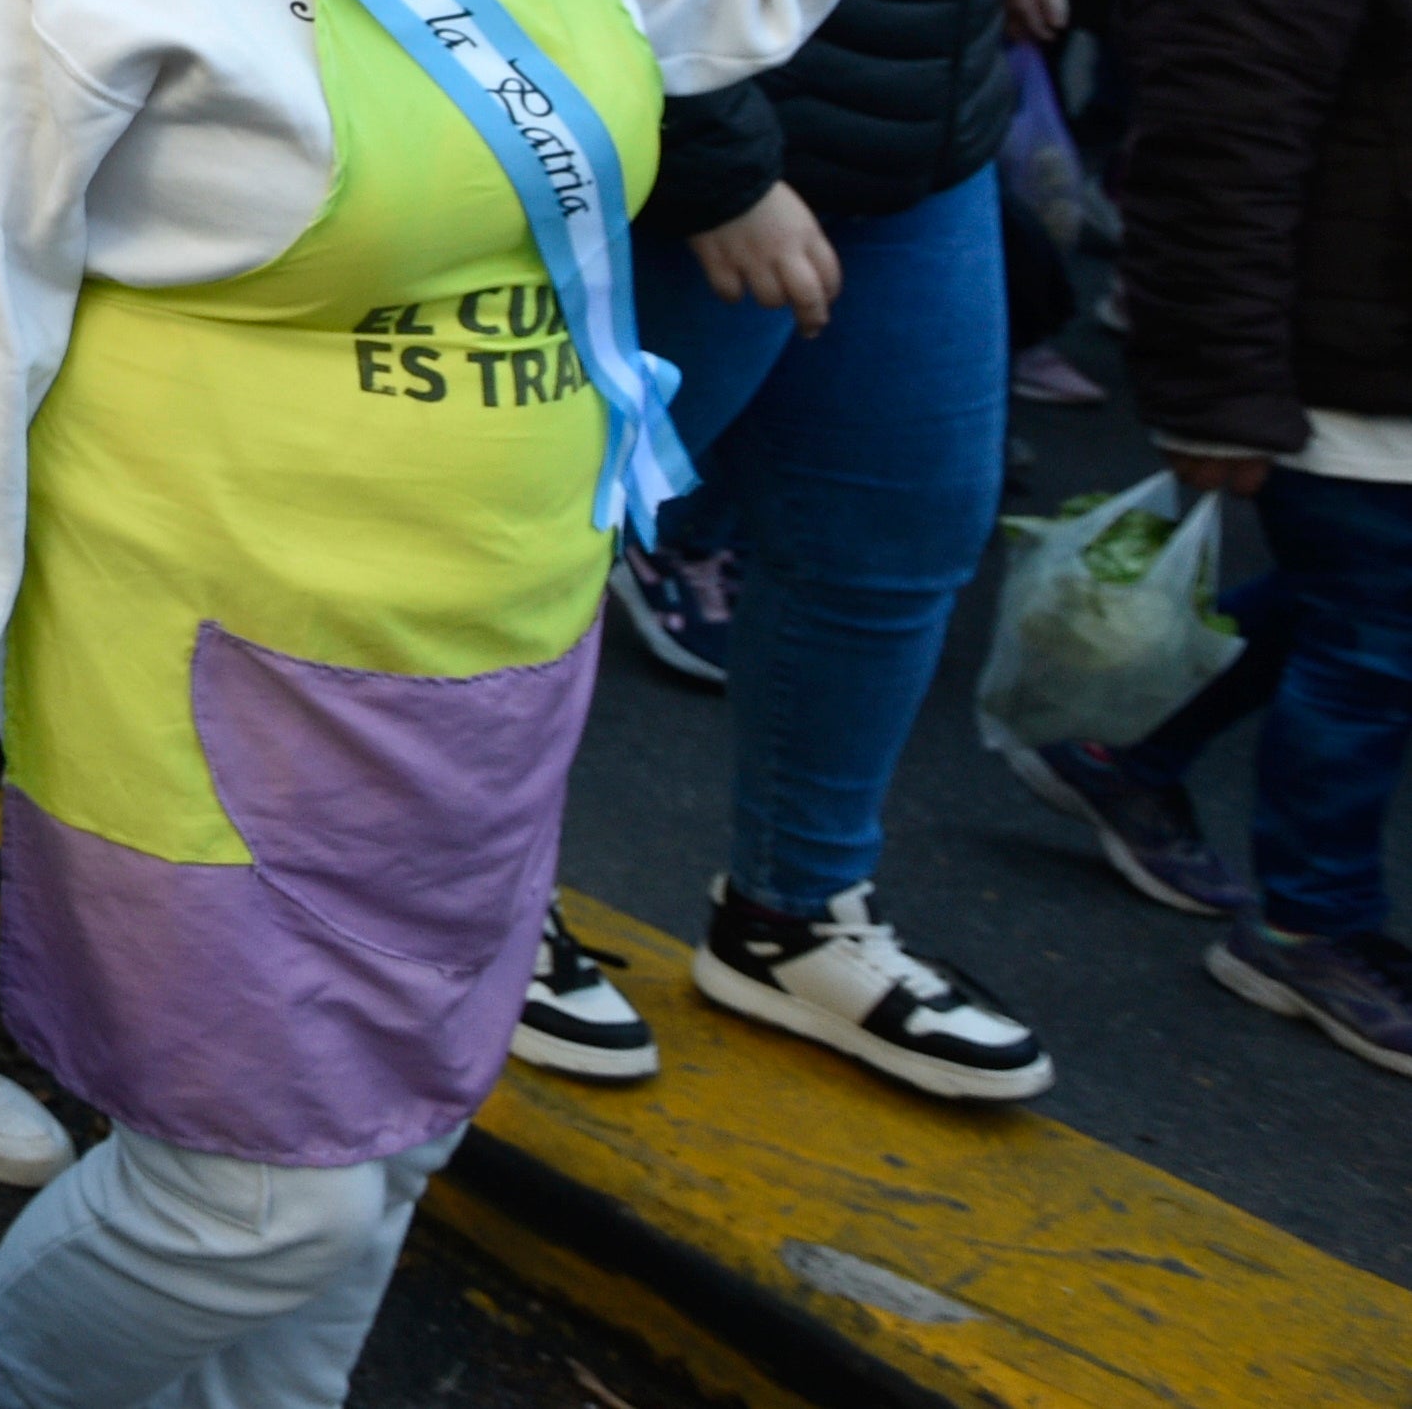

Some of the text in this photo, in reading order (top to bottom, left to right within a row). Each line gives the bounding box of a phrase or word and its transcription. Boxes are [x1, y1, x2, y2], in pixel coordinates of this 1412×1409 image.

[426, 5, 477, 52] la
[484, 59, 591, 219] Patria
[353, 303, 434, 335] EL
[355, 340, 448, 403] ES
